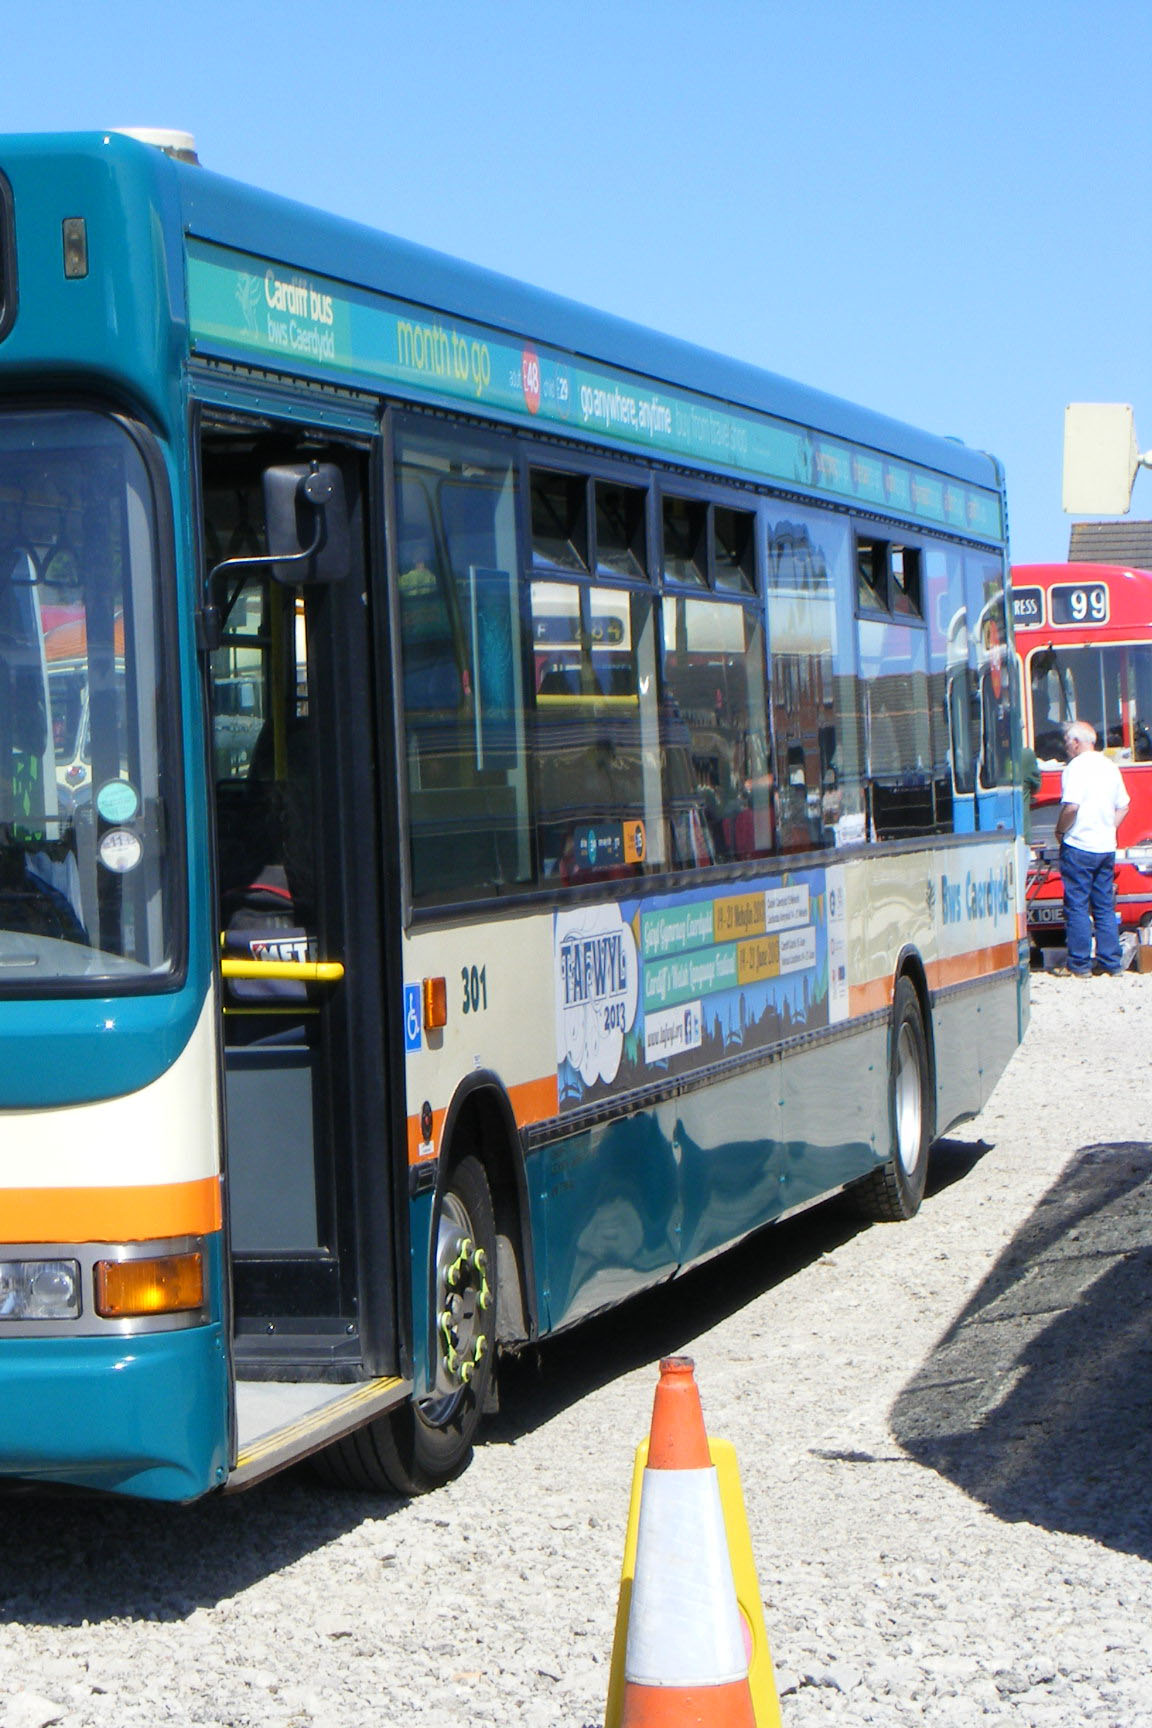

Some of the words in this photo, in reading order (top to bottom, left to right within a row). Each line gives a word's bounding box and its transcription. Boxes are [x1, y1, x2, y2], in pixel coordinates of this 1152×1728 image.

[264, 269, 308, 318] Cardiff
[309, 282, 333, 326] bus
[397, 319, 450, 376] month
[452, 326, 469, 381] to
[471, 341, 491, 397] go
[523, 360, 539, 394] £48
[1070, 589, 1105, 620] 99
[941, 874, 961, 925] Bws
[461, 963, 488, 1014] 301
[562, 935, 628, 1004] TAFWYL
[604, 1003, 626, 1033] 2013
